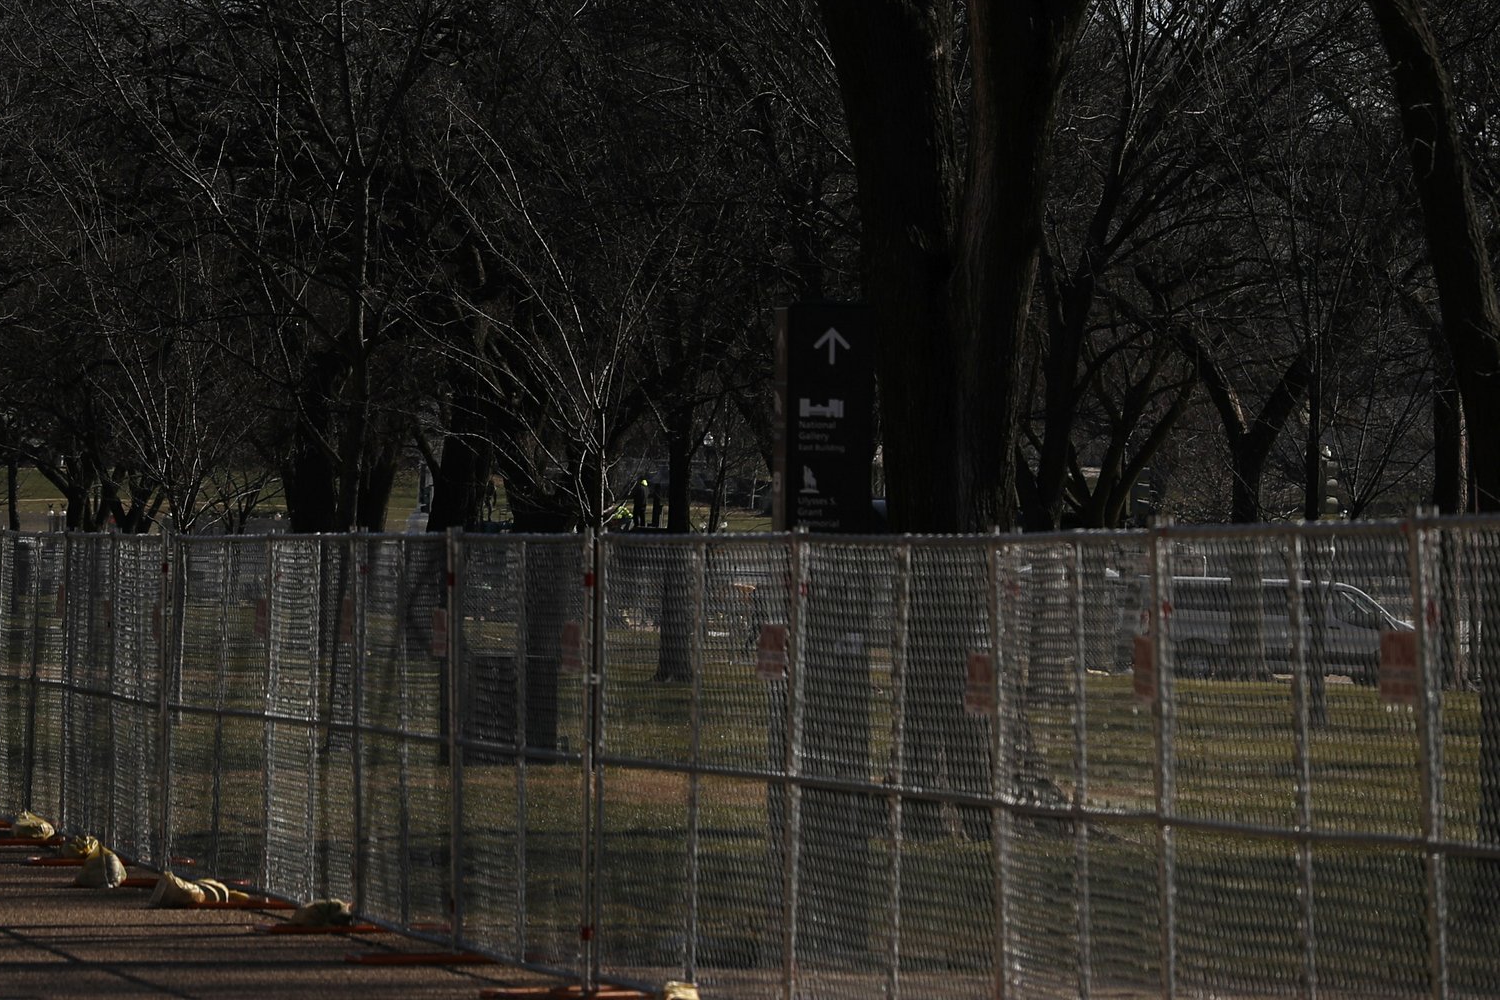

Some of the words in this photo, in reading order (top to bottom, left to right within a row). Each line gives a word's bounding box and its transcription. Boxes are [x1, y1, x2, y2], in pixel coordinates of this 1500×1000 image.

[798, 420, 837, 429] National
[798, 431, 829, 442] Gallery
[815, 444, 845, 453] Building
[797, 497, 828, 506] Ulysses
[797, 507, 823, 517] Grant
[797, 518, 840, 528] Memorial
